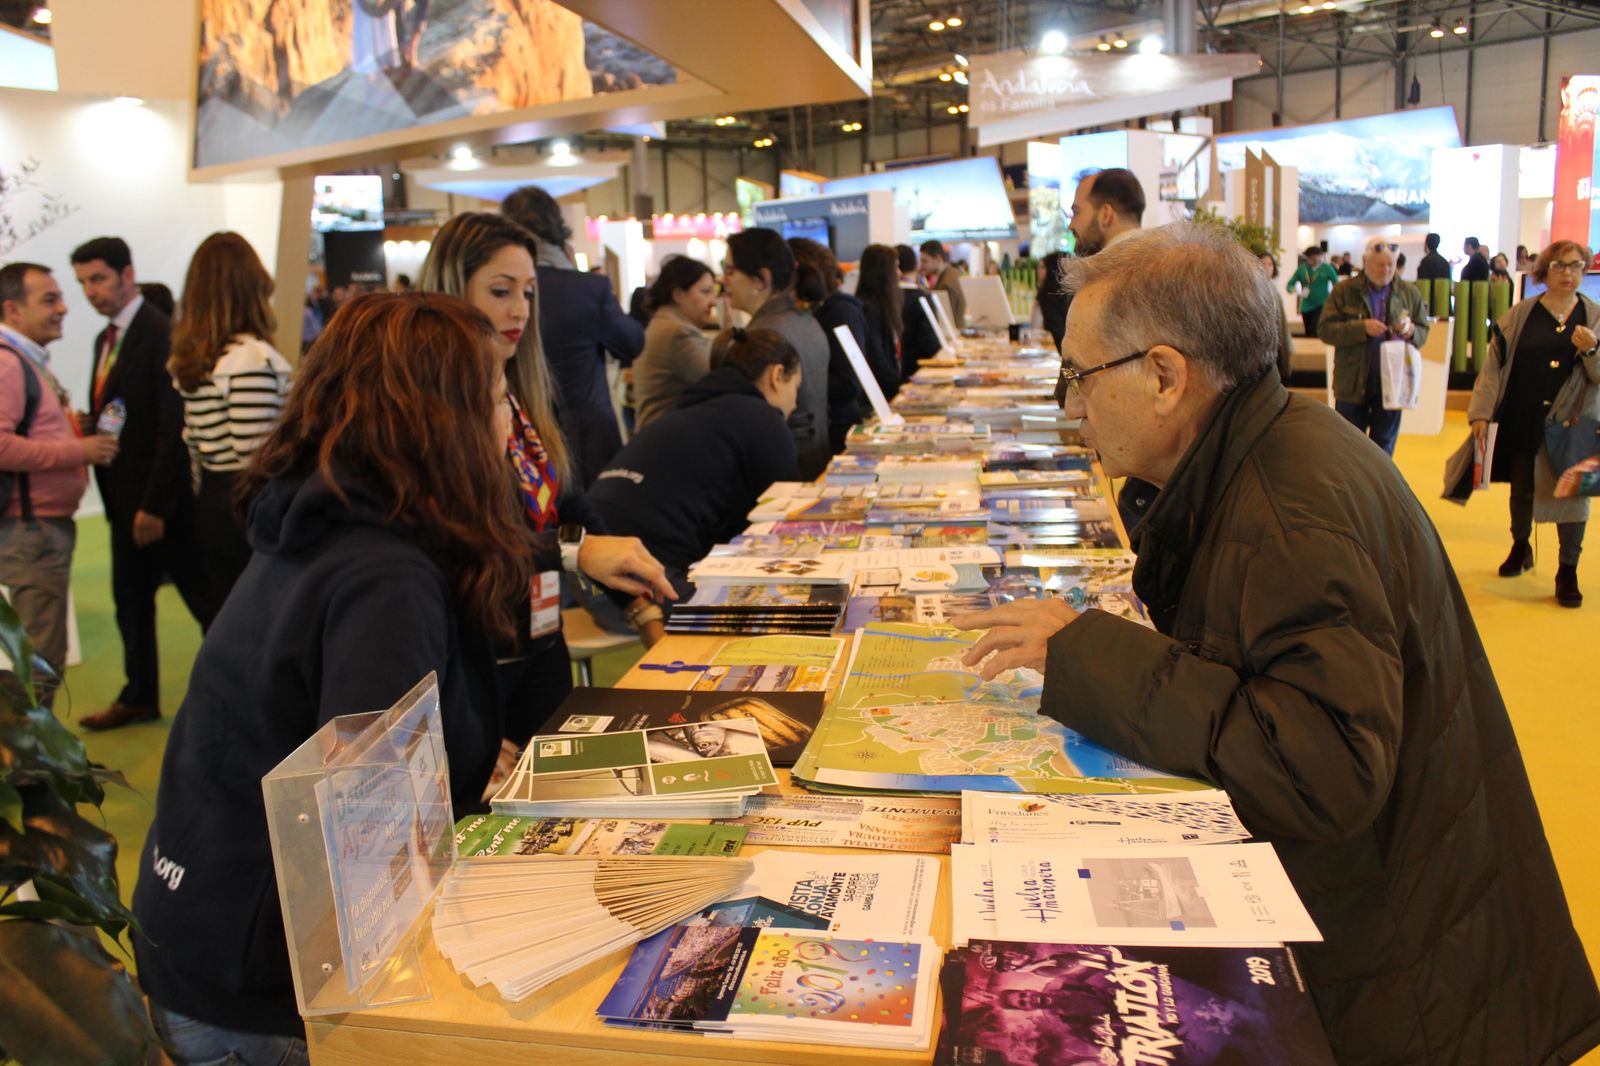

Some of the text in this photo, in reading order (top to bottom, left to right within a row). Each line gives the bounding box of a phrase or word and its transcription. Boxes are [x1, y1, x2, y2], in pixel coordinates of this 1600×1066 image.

[786, 818, 823, 829] PVP
[820, 871, 847, 919] AYAMONTE
[1016, 879, 1052, 923] Huelva
[759, 948, 791, 996] Feliz año
[1244, 956, 1276, 986] 2019
[1104, 946, 1185, 1066] TRIATLÓN
